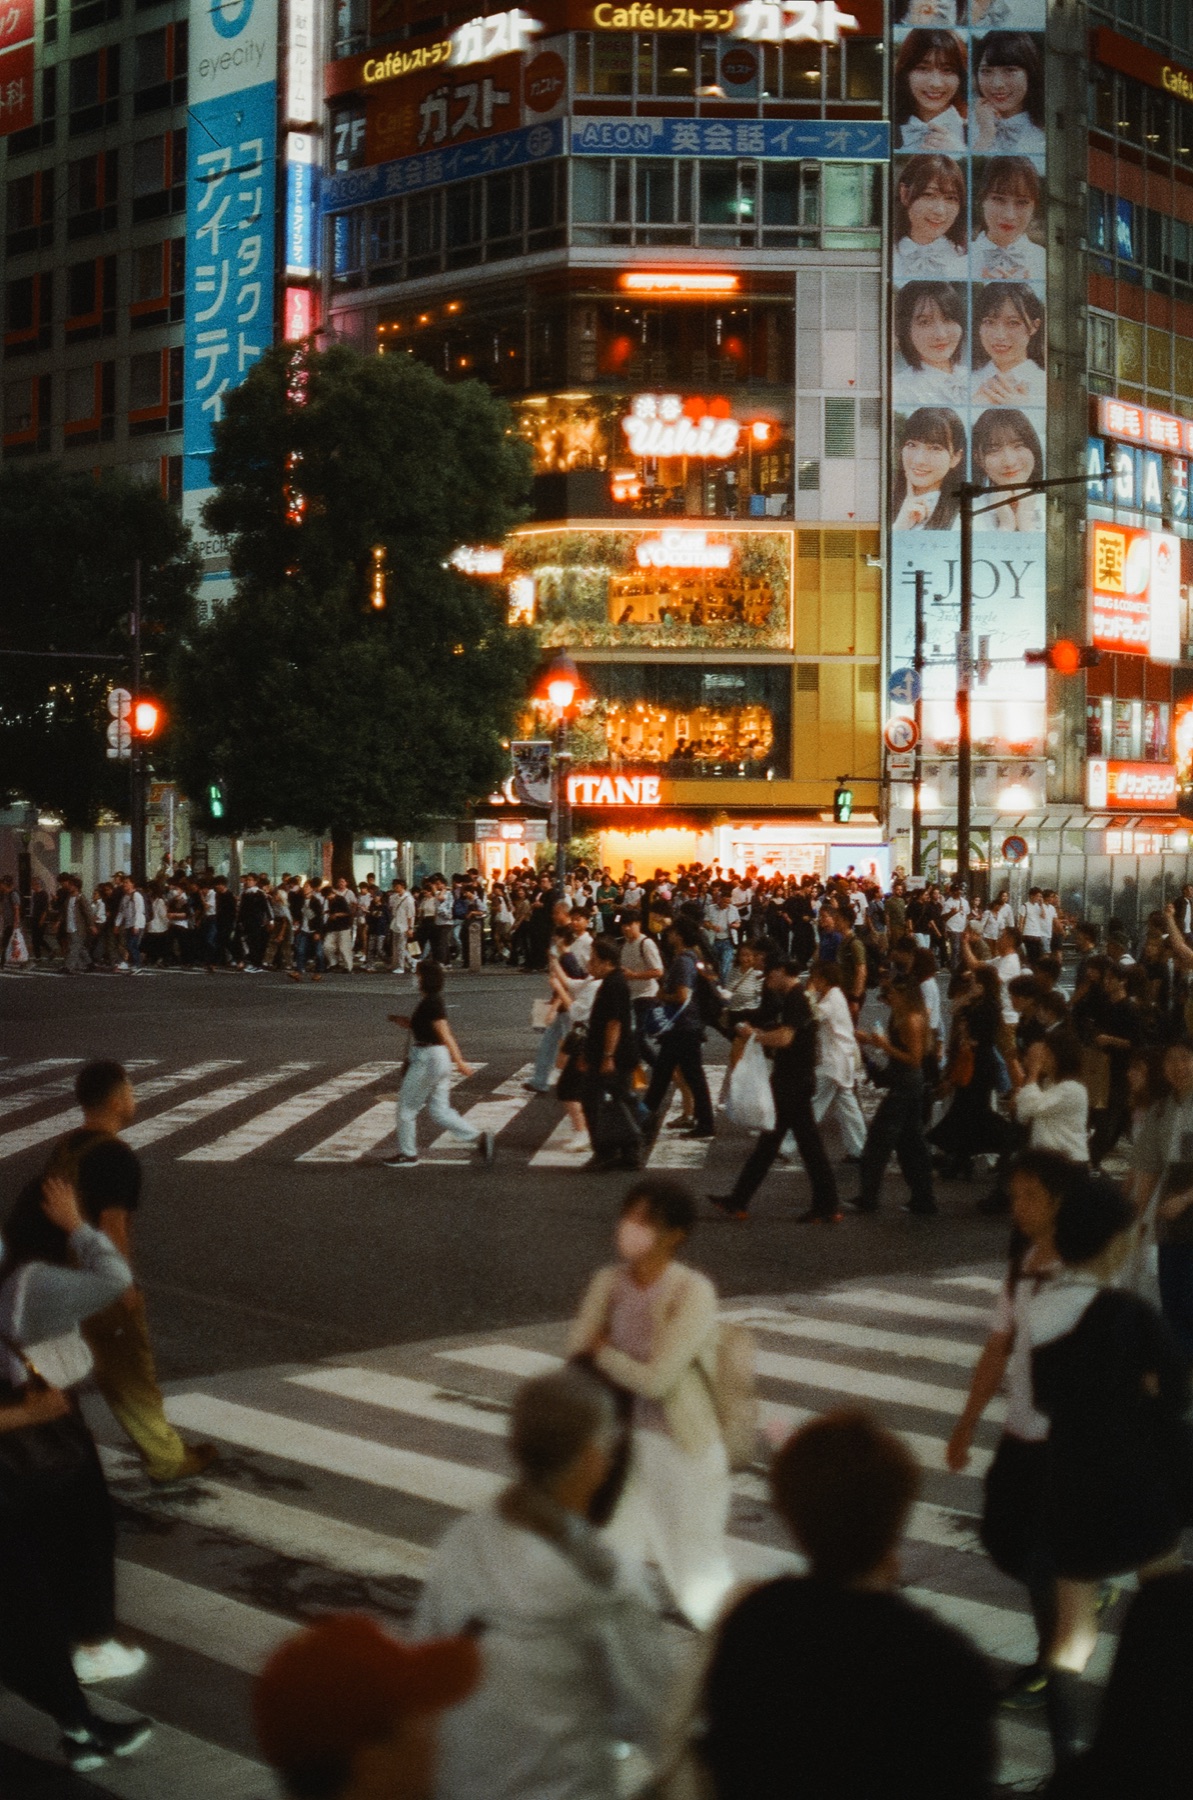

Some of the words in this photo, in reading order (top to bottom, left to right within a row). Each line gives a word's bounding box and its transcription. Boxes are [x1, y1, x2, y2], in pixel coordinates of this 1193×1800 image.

[452, 9, 541, 65] ガスト
[738, 0, 858, 42] ガスト
[199, 40, 265, 80] eyecity
[335, 117, 366, 154] 7F
[417, 78, 511, 146] ガスト
[584, 123, 651, 147] AEON
[671, 122, 882, 152] 英会話イーオン
[386, 137, 520, 192] 英会話イーオン
[195, 147, 231, 422] アイシティ
[236, 138, 263, 387] コンタクト
[1087, 448, 1161, 505] AGA
[1098, 537, 1122, 586] 薬
